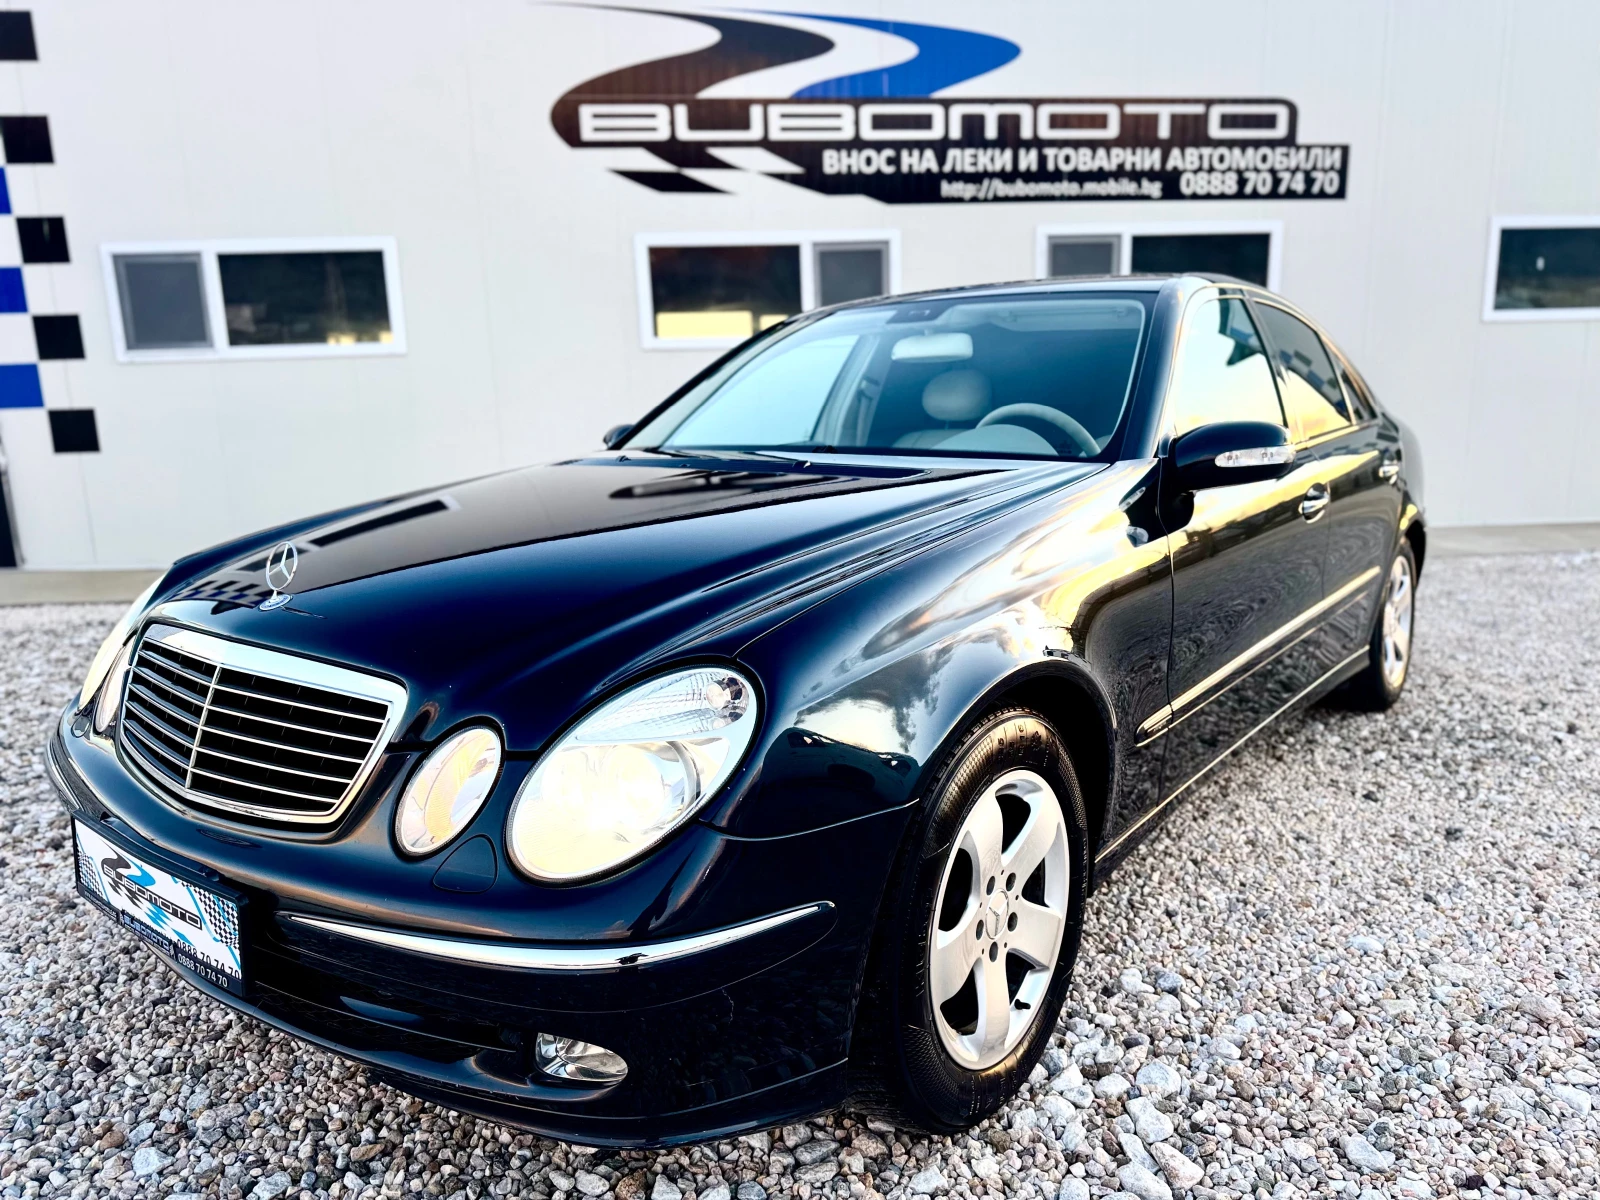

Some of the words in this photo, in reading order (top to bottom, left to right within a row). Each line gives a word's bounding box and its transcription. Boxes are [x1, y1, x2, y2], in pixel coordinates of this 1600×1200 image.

[578, 103, 1291, 142] BUBOMOTO
[822, 149, 897, 175] ВНОС
[900, 148, 940, 174] НА
[942, 147, 1013, 173] ЛЕКИ
[1018, 147, 1039, 173] И
[1042, 147, 1162, 172] ТОВАРНИ
[1165, 146, 1342, 171] АВТОМОБИЛИ
[940, 177, 1163, 200] http://bubomoto.mobile.bg
[1180, 171, 1239, 196] 0888
[1242, 171, 1273, 195] 70
[1276, 171, 1306, 195] 74
[1310, 170, 1340, 195] 70
[103, 864, 201, 927] BUBOMOTO
[200, 951, 212, 965] 70
[195, 963, 206, 976] 70
[206, 968, 217, 982] 74
[217, 974, 228, 988] 70
